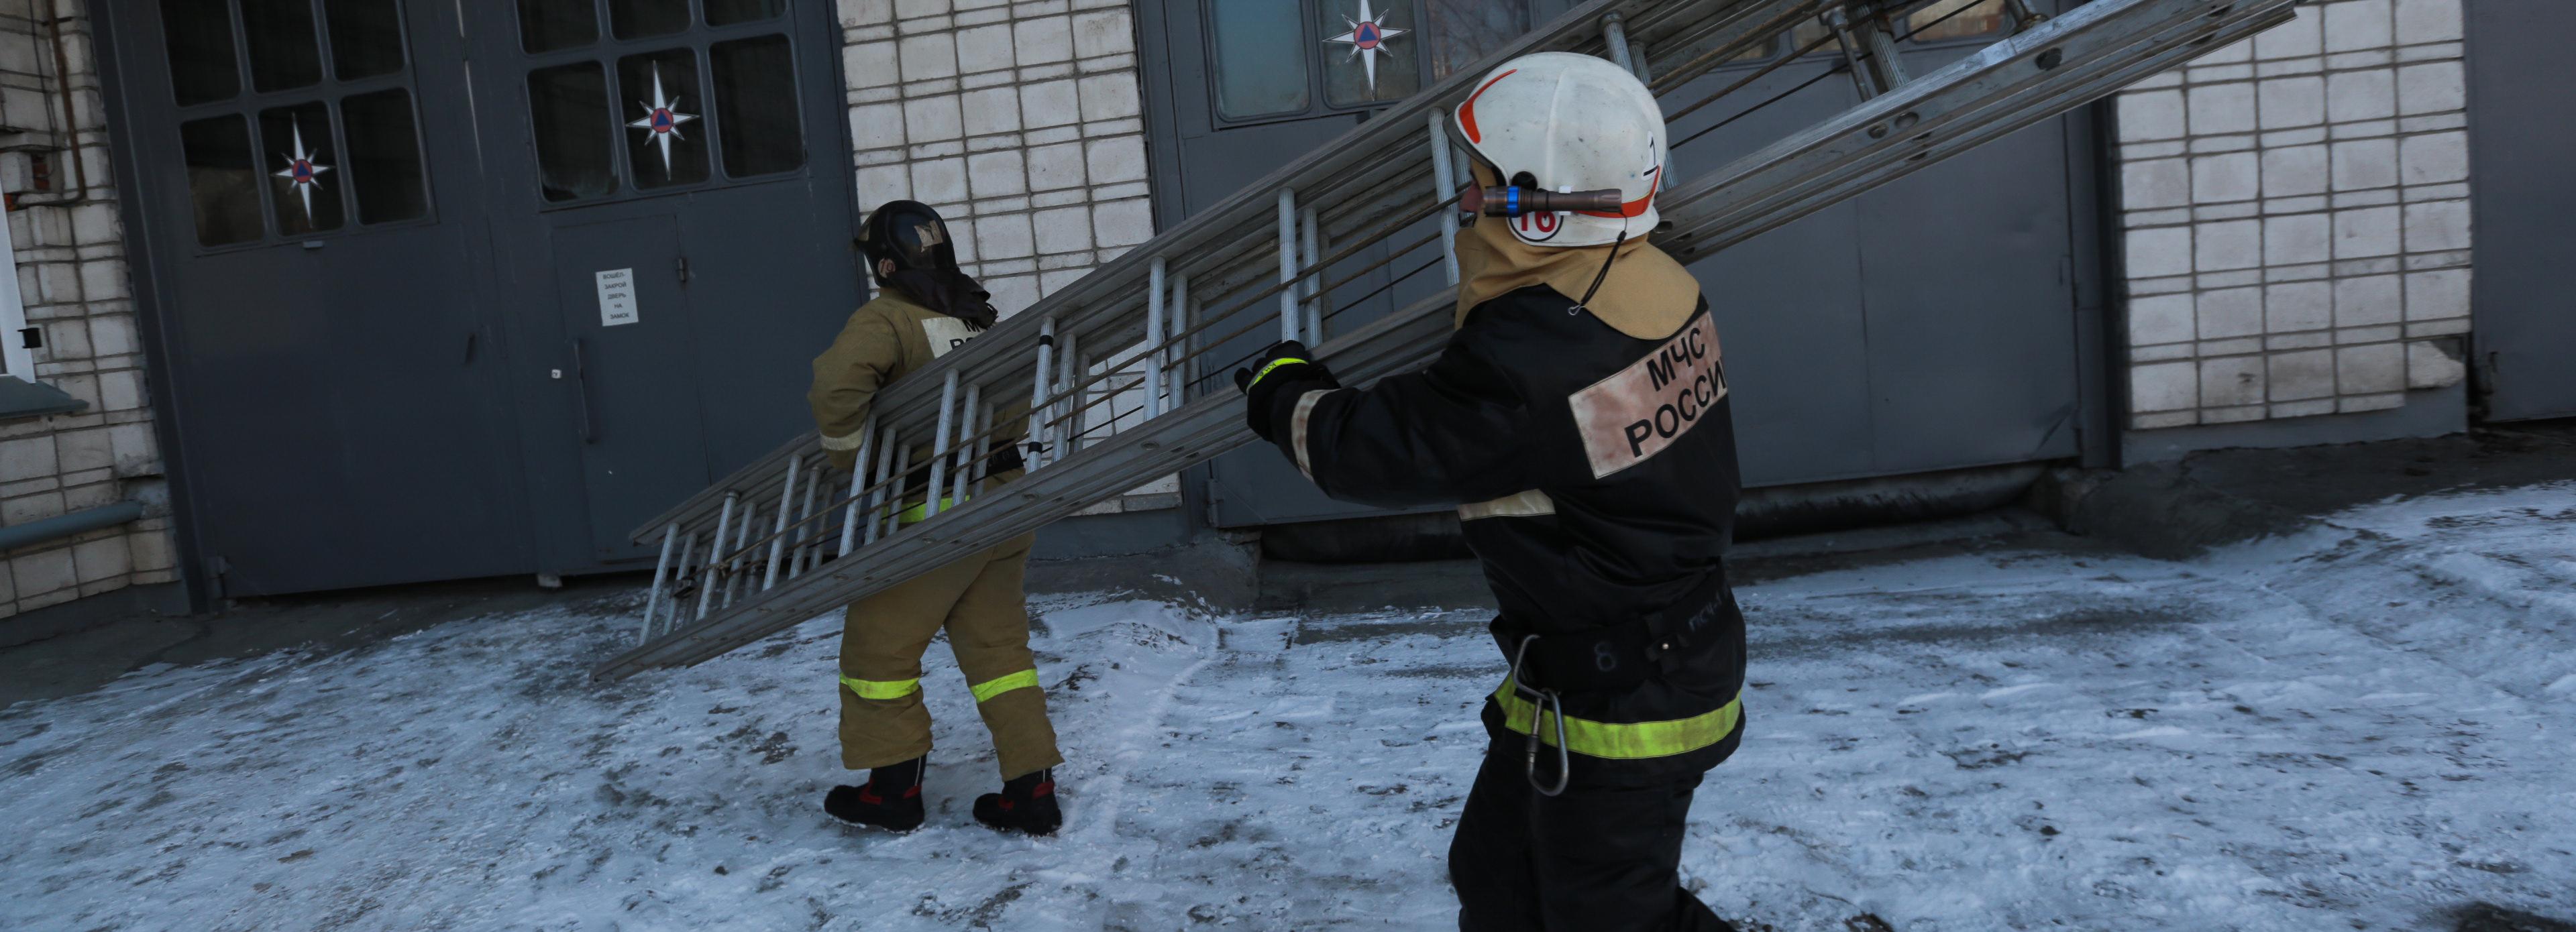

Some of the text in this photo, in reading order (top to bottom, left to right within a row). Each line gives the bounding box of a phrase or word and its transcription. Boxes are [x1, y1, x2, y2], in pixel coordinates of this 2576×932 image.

[604, 282, 627, 290] ЗАКРОЙ
[1647, 328, 1705, 392] МЧС
[1624, 357, 1726, 458] РОССИ
[1593, 641, 1616, 672] 8
